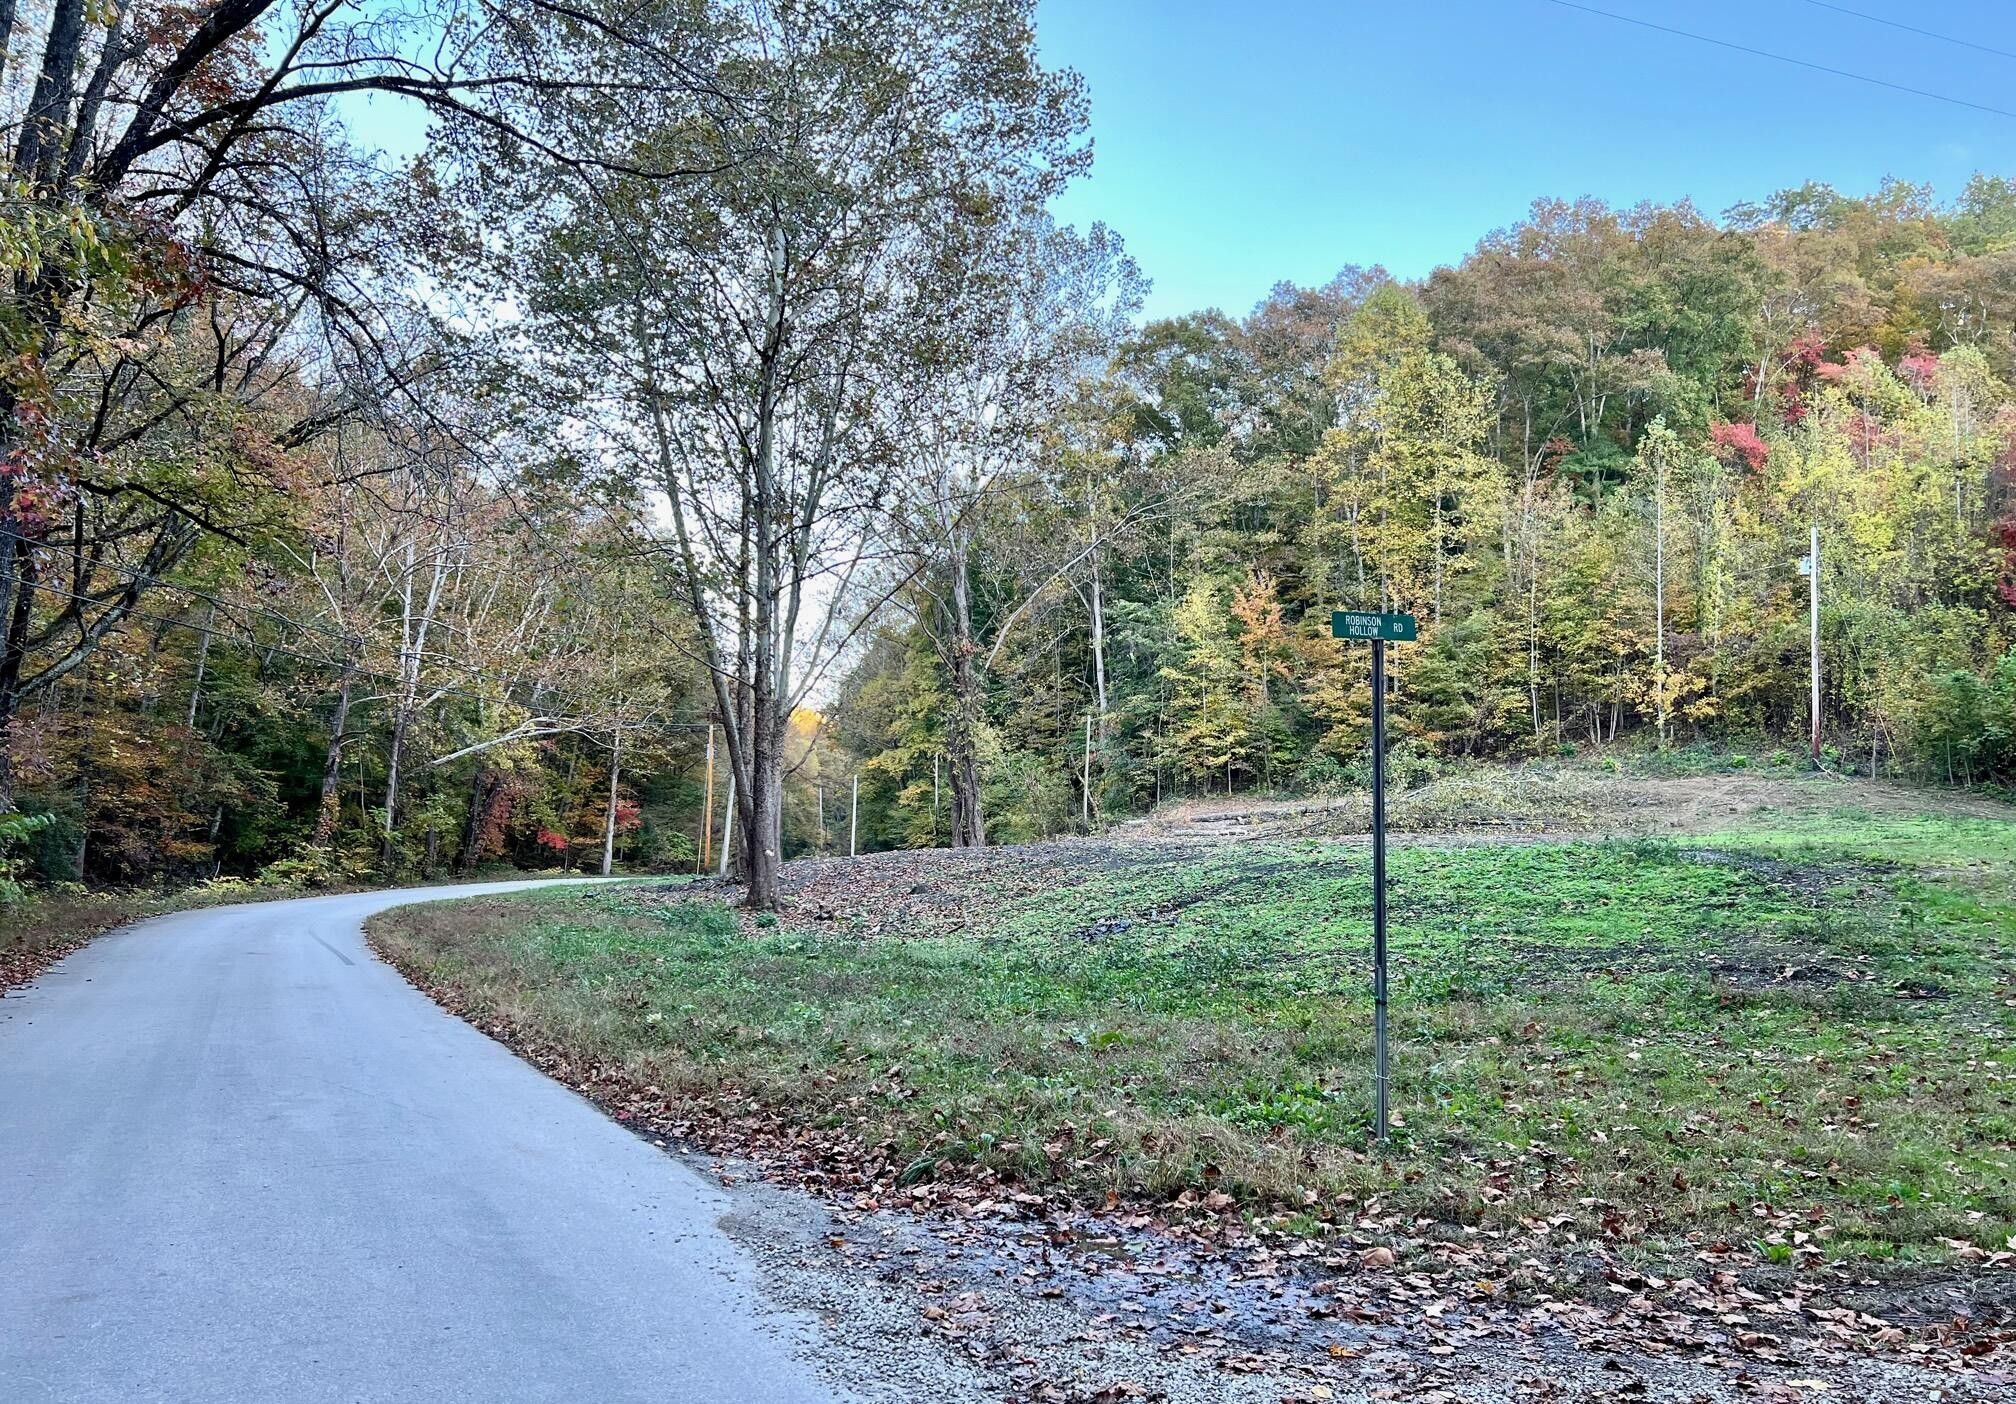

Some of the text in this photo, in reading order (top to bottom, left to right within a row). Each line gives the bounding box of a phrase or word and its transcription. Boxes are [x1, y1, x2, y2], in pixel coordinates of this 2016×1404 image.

[1345, 615, 1381, 626] ROBINSON
[1349, 626, 1378, 635] HOLLOW
[1393, 623, 1403, 632] RD
